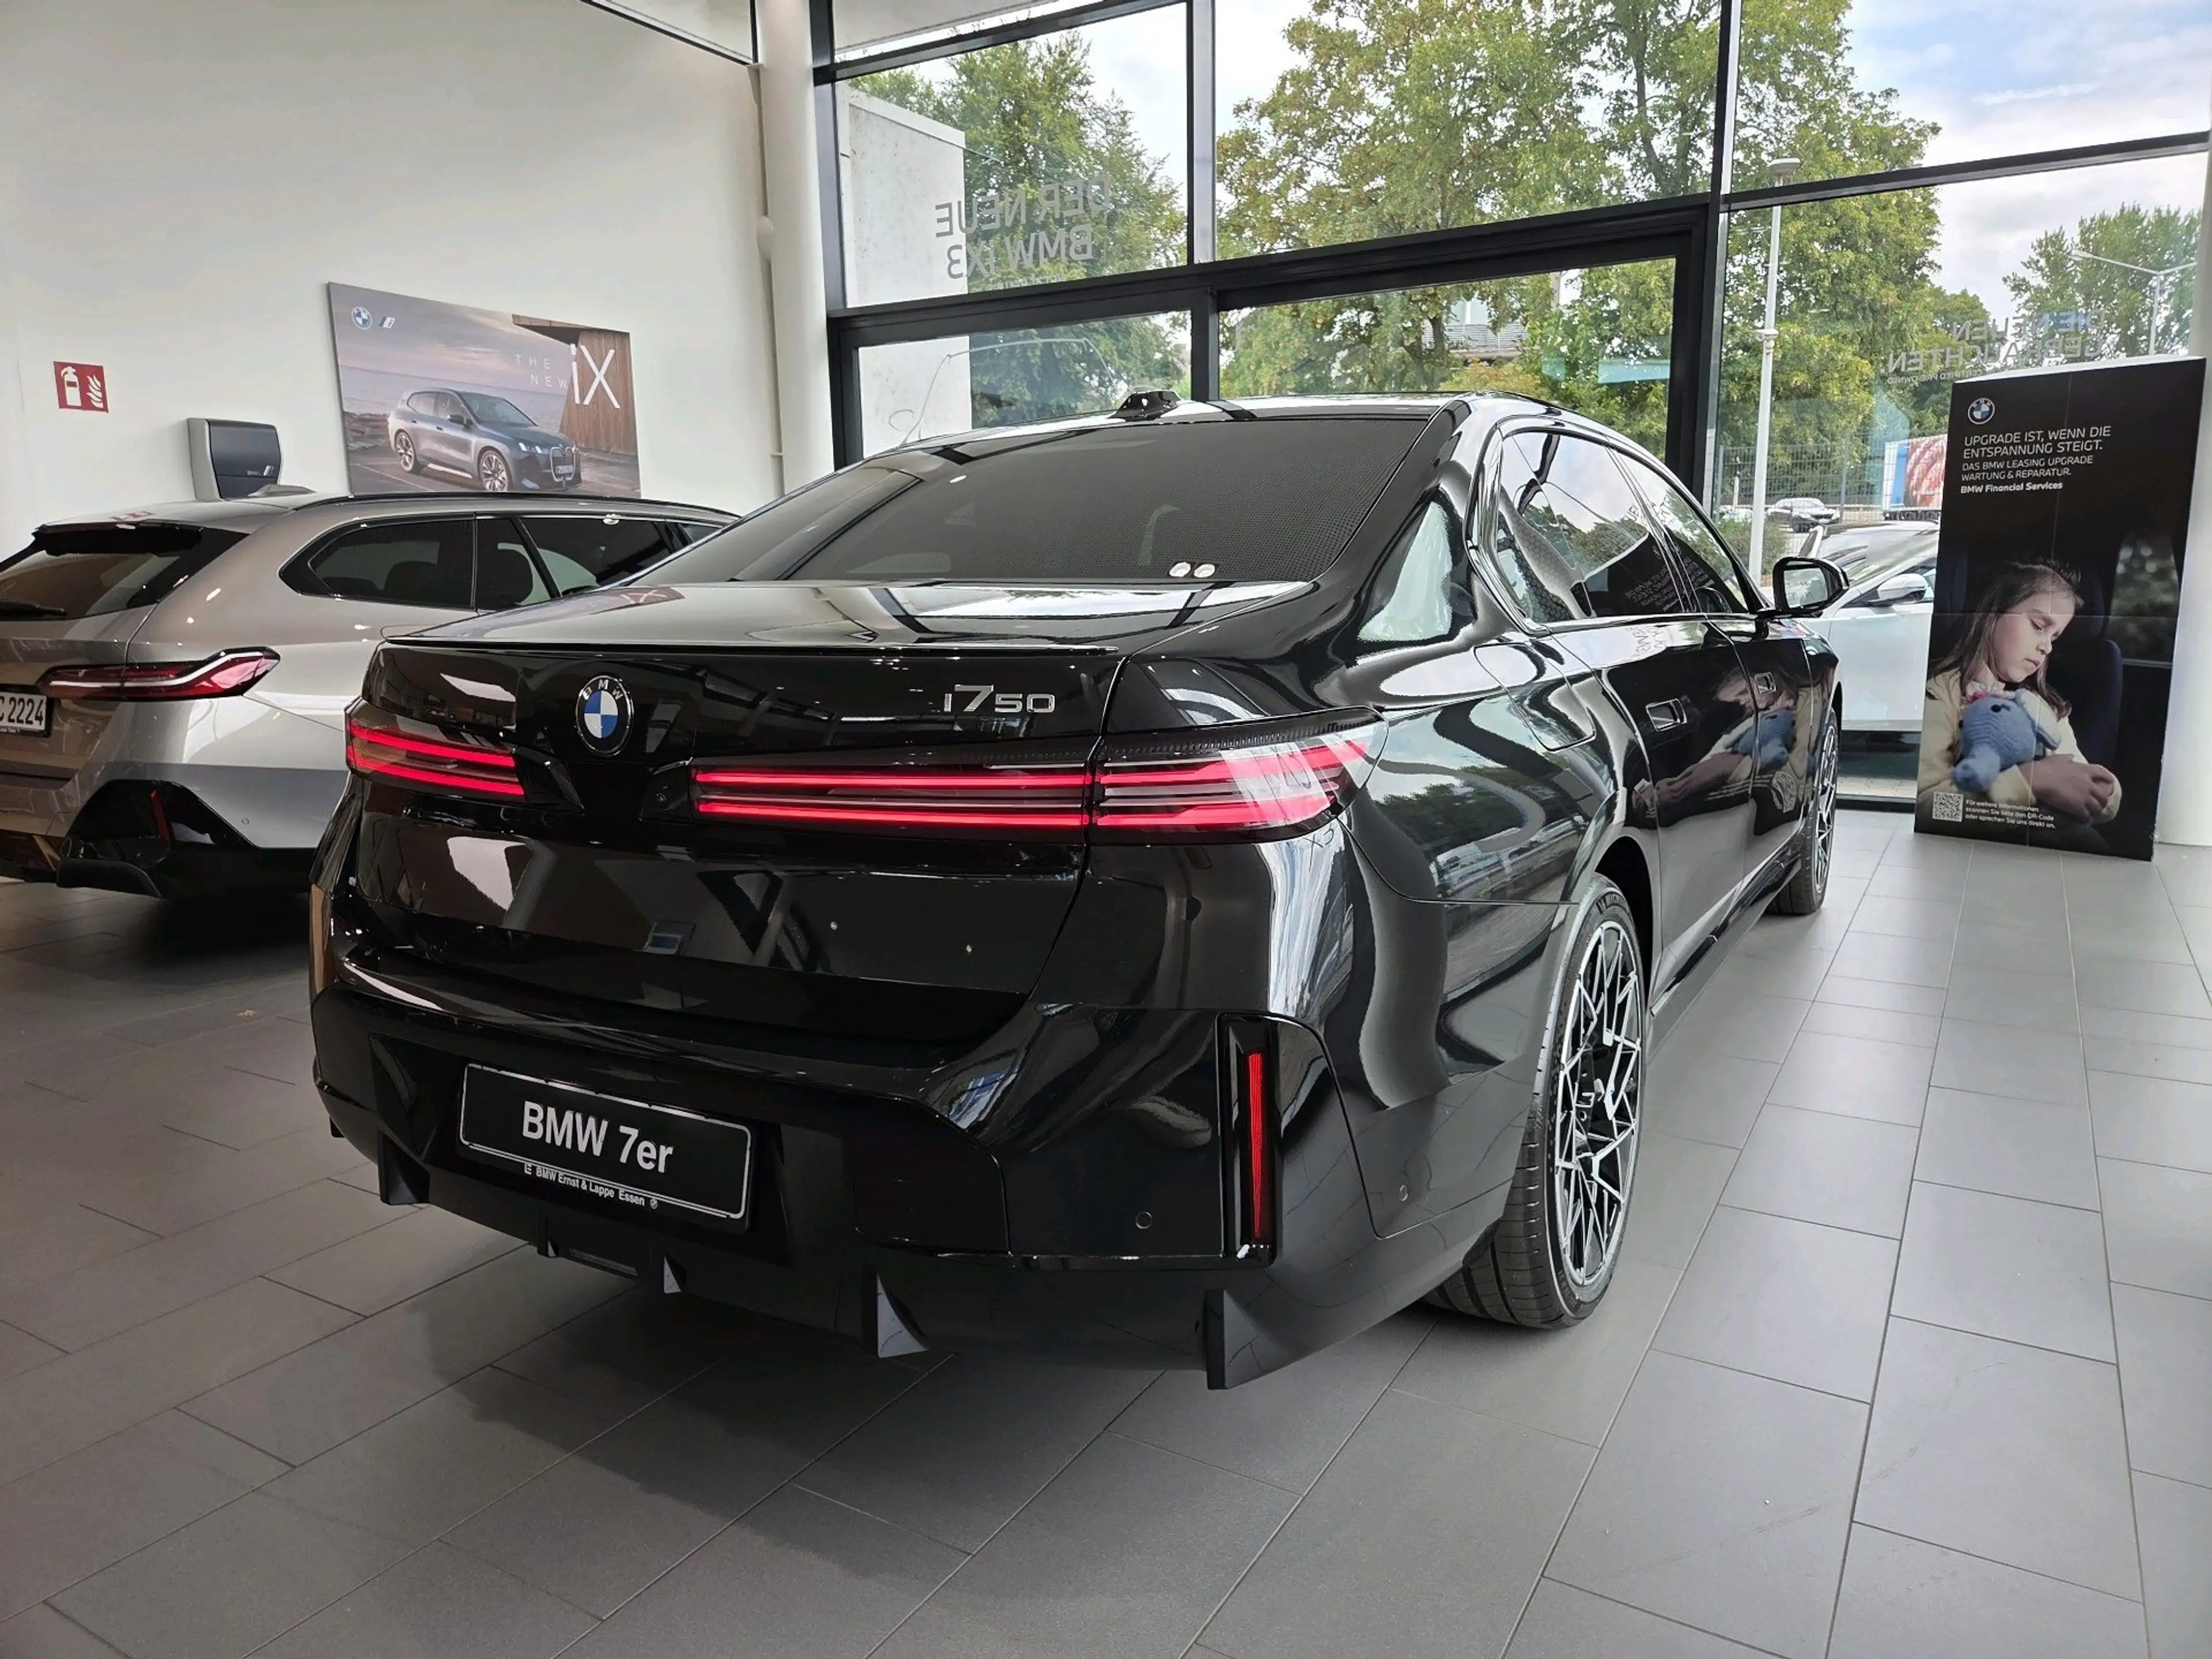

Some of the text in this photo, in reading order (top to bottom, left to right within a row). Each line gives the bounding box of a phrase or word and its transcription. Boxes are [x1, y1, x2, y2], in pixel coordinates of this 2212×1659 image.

[514, 354, 551, 370] THE
[530, 374, 567, 388] NEW
[1964, 425, 2111, 447] UPGRADE IST, WENN DIE
[1963, 440, 2103, 459] ENTSPANNUNG STEIGT.
[1962, 454, 2094, 471] DAS BMW LEASING UPGRADE
[1961, 471, 2006, 481] WARTUNG
[2007, 470, 2014, 479] &
[1960, 481, 2063, 494] BMW Financial Services
[582, 679, 624, 700] BMW
[7, 696, 44, 726] 2224
[522, 1100, 674, 1173] BMW 7er
[536, 1166, 645, 1206] BMW Ernst & Lappe Essen
